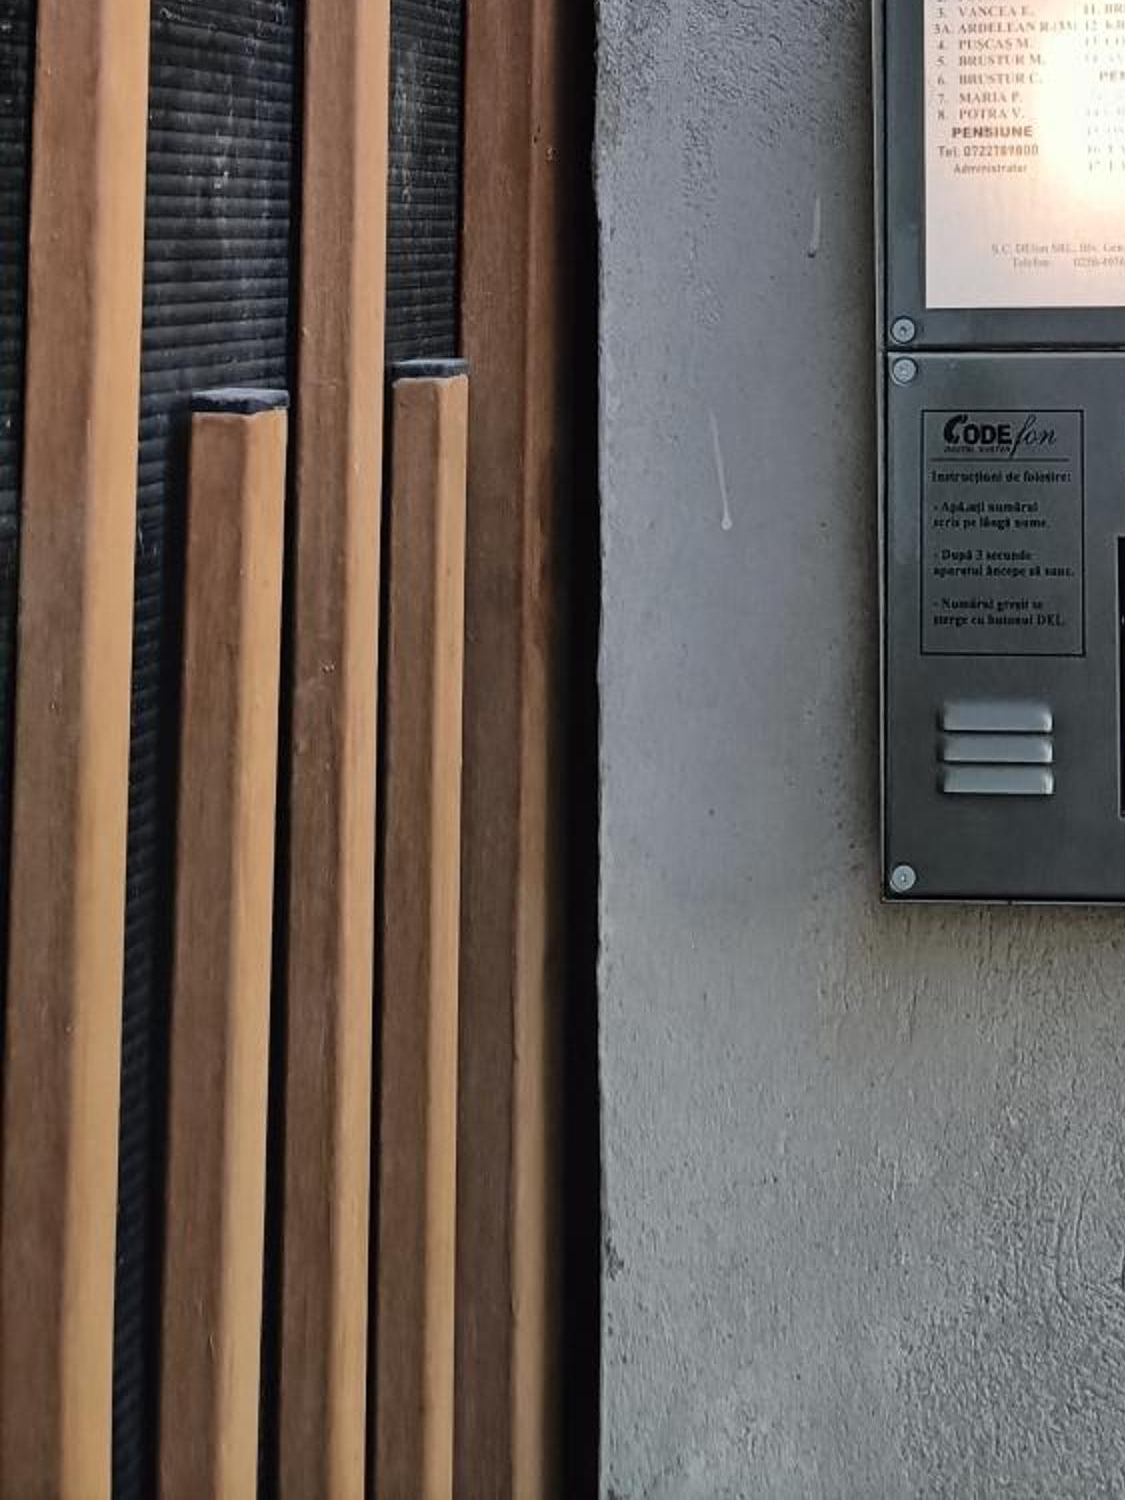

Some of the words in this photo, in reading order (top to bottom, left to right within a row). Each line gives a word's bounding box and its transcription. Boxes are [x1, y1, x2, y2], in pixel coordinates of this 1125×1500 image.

[958, 7, 1017, 18] VANCEA
[958, 23, 1035, 34] ARDELEAN
[959, 56, 1025, 67] BRUSTUR
[959, 93, 1007, 104] MARIA
[959, 108, 1010, 120] POTRA
[952, 126, 1033, 138] PENSIUNE
[954, 164, 1027, 174] Administrator
[1006, 471, 1020, 483] de
[963, 518, 976, 531] pe
[971, 616, 985, 626] cu
[988, 614, 1033, 626] butonul
